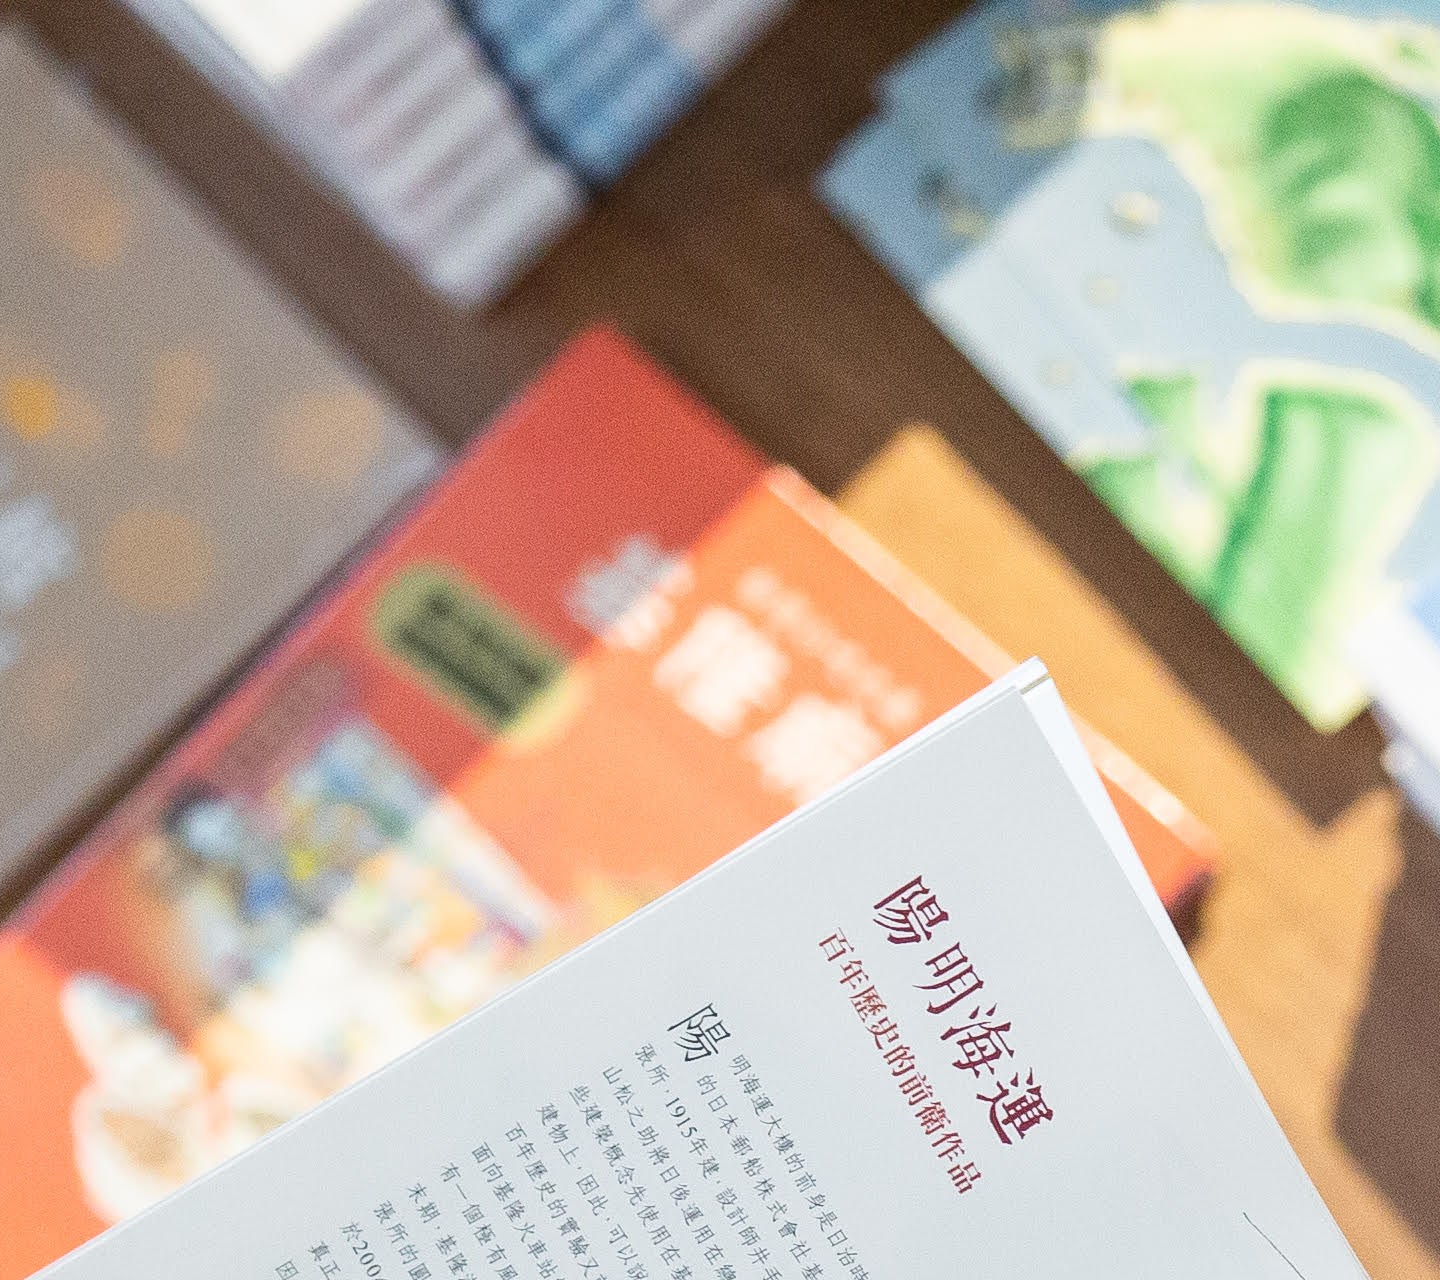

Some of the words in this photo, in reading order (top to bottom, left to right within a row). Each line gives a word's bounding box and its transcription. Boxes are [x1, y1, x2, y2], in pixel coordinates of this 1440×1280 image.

[666, 1002, 732, 1063] 陽
[818, 933, 982, 1195] 百年歷史的前衛作品
[872, 874, 1054, 1146] 陽明海運
